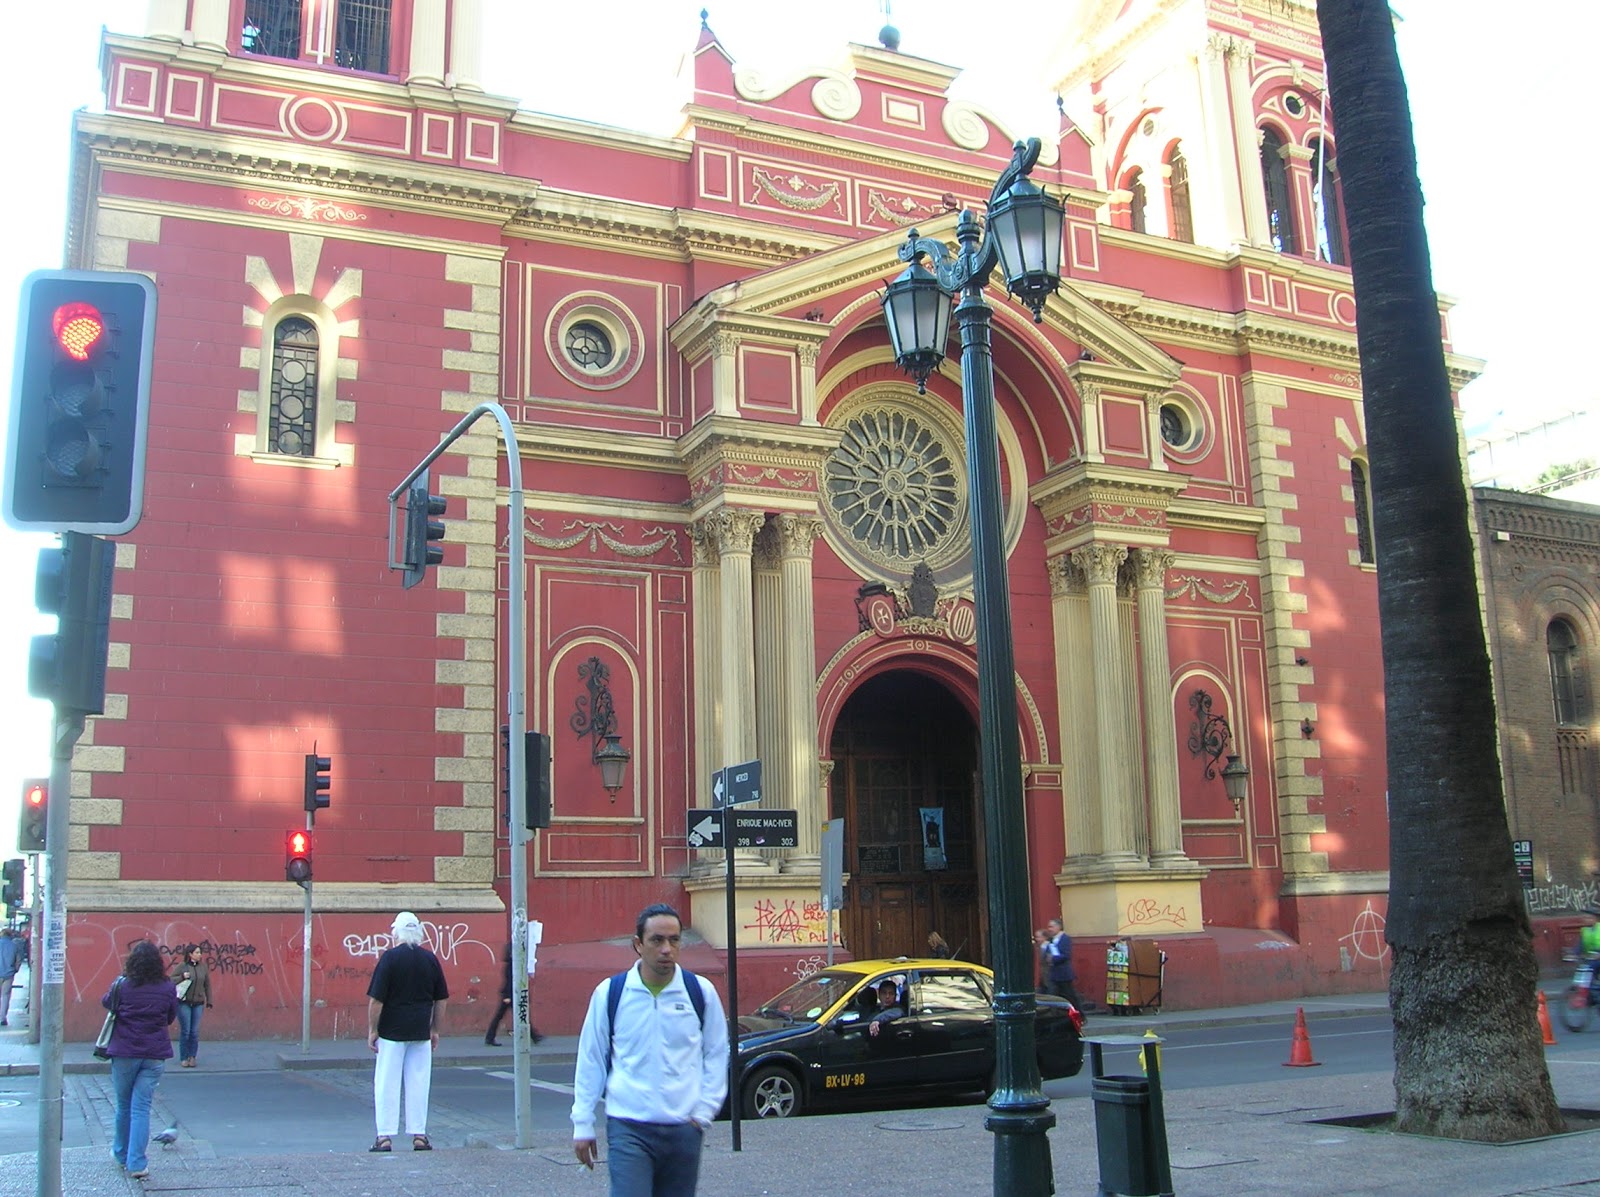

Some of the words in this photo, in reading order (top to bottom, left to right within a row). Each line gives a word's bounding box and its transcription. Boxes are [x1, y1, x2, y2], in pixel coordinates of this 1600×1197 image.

[736, 818, 762, 828] ENRIQUE
[763, 818, 793, 828] MAC-IVER
[737, 837, 750, 847] 398
[781, 837, 794, 847] 302
